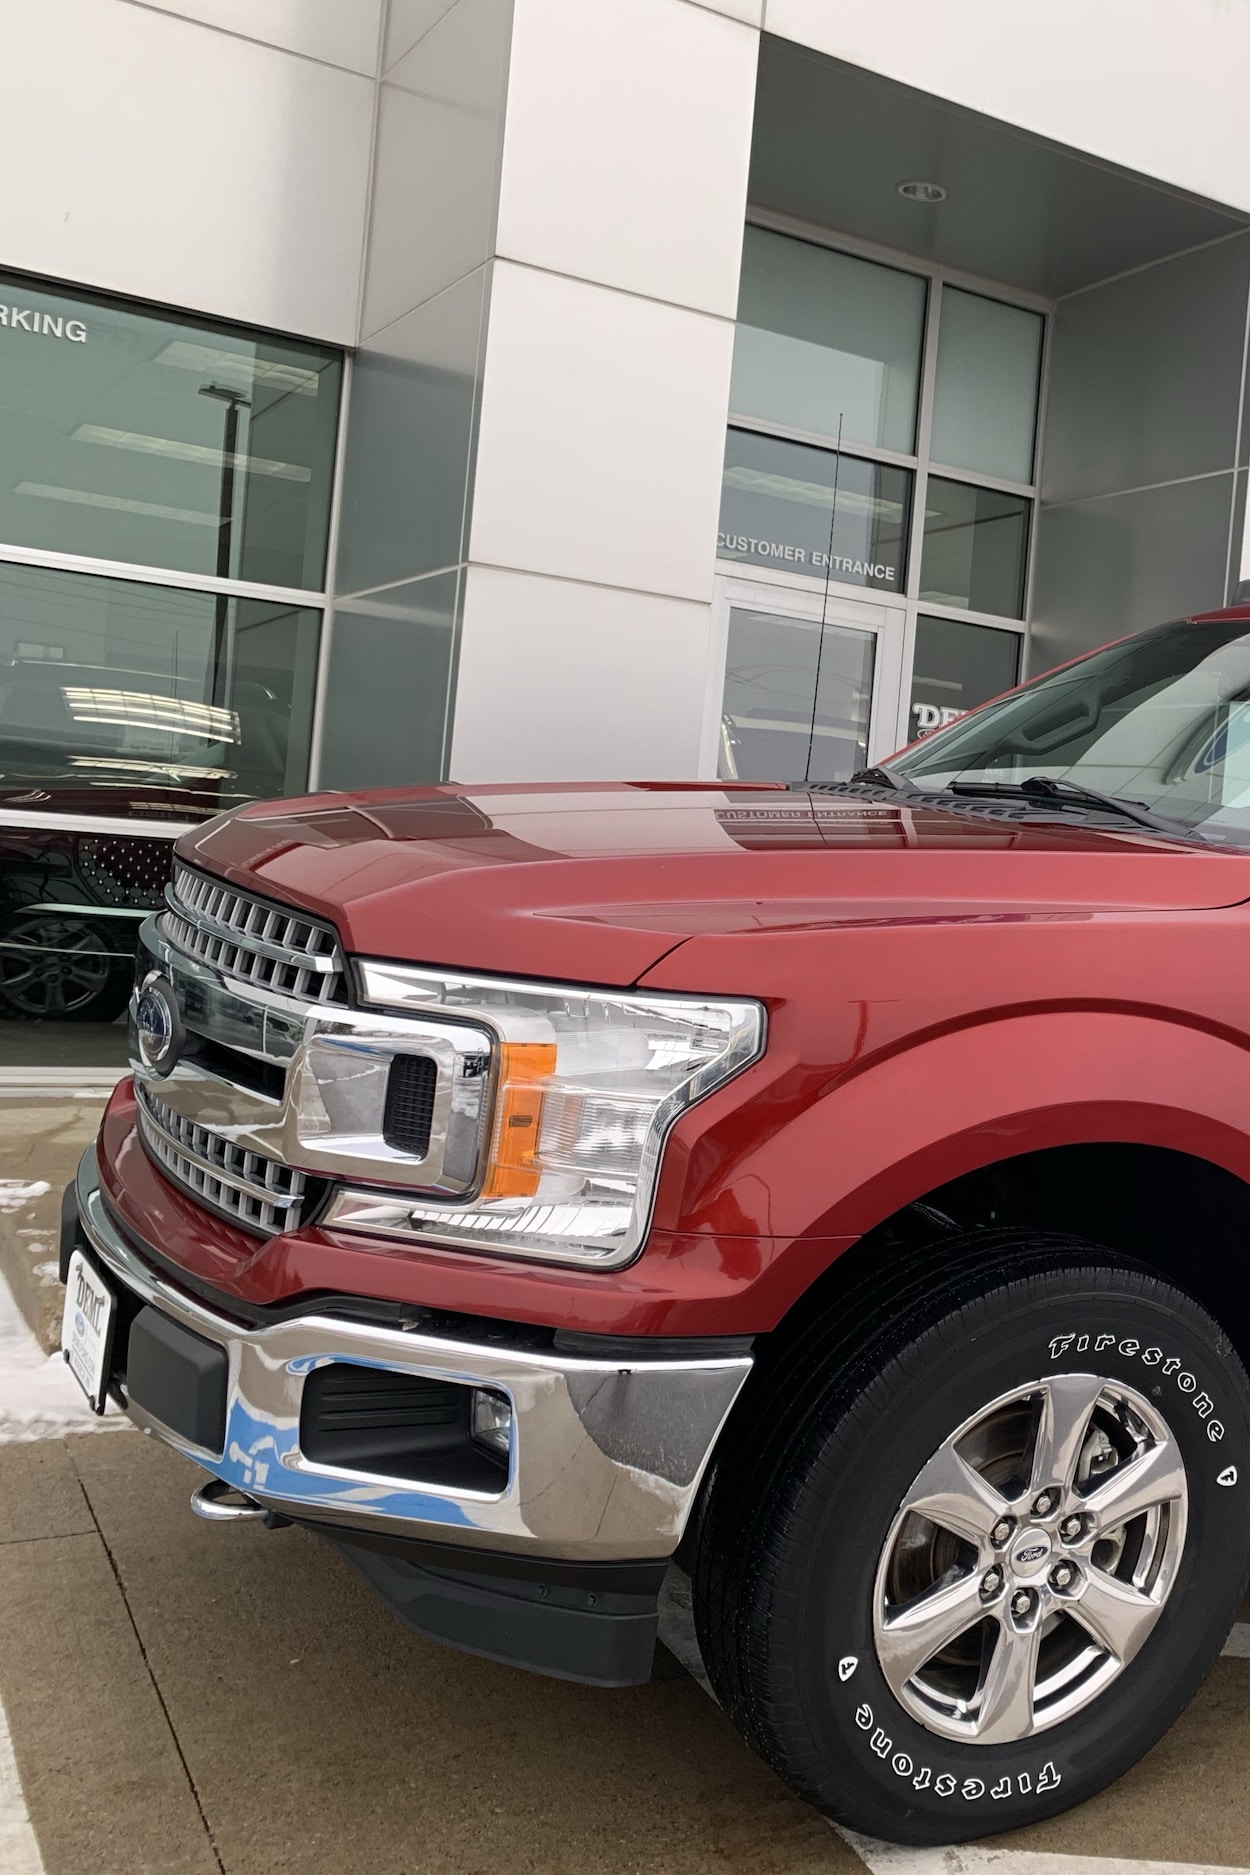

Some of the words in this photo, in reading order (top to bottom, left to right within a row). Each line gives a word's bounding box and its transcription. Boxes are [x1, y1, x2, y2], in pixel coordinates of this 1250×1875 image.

[717, 533, 805, 562] CUSTOMER
[812, 552, 895, 581] ENTRANCE
[912, 703, 969, 728] DE
[1049, 1333, 1224, 1443] Firestone
[1020, 1547, 1044, 1562] Ford
[855, 1704, 1062, 1800] Firestone
